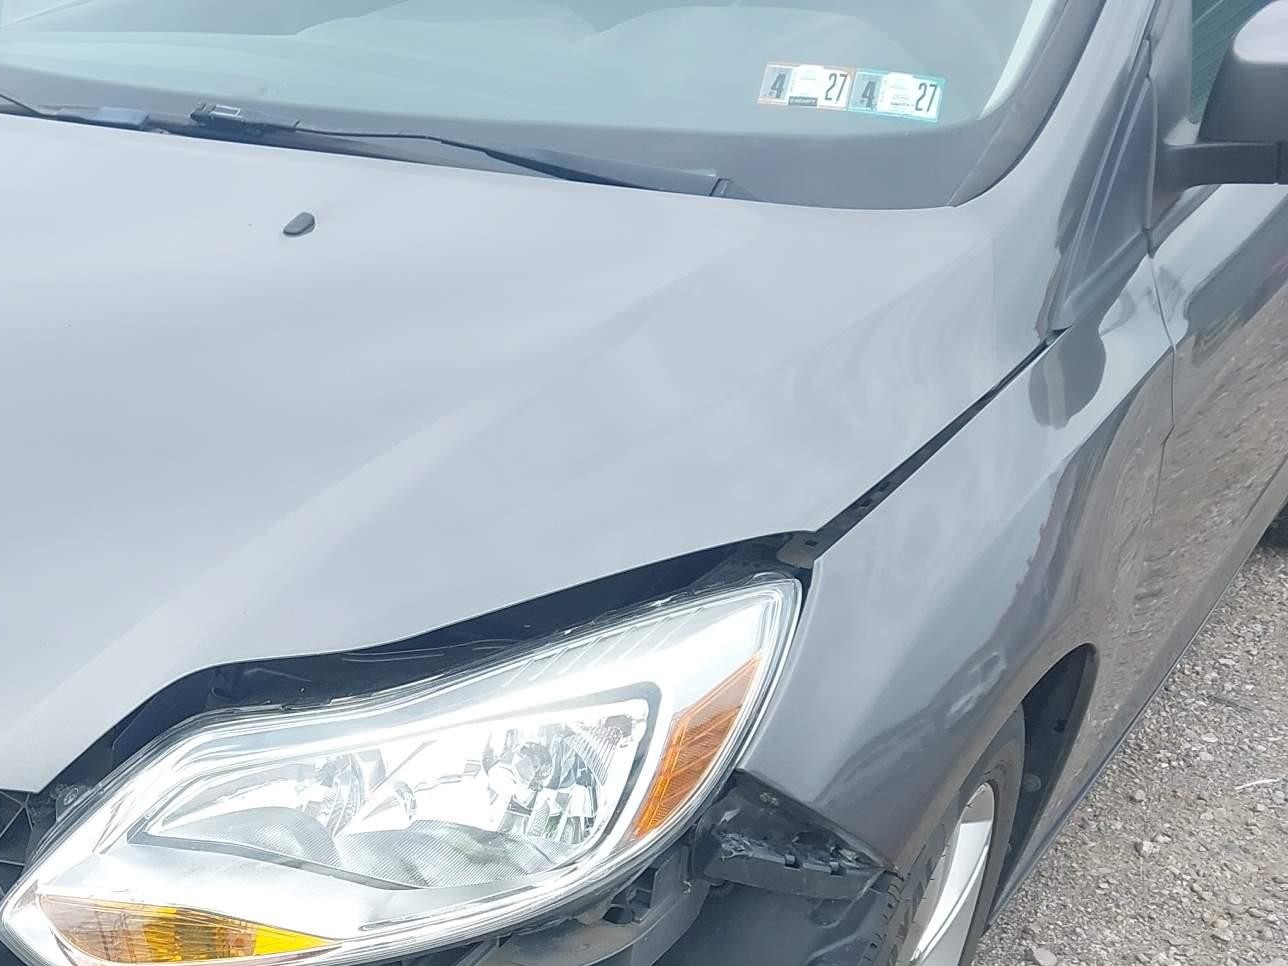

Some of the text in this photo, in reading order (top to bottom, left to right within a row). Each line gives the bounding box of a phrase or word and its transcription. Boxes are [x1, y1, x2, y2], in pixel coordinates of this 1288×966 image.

[769, 72, 848, 102] 4 27
[861, 81, 938, 113] 4 27
